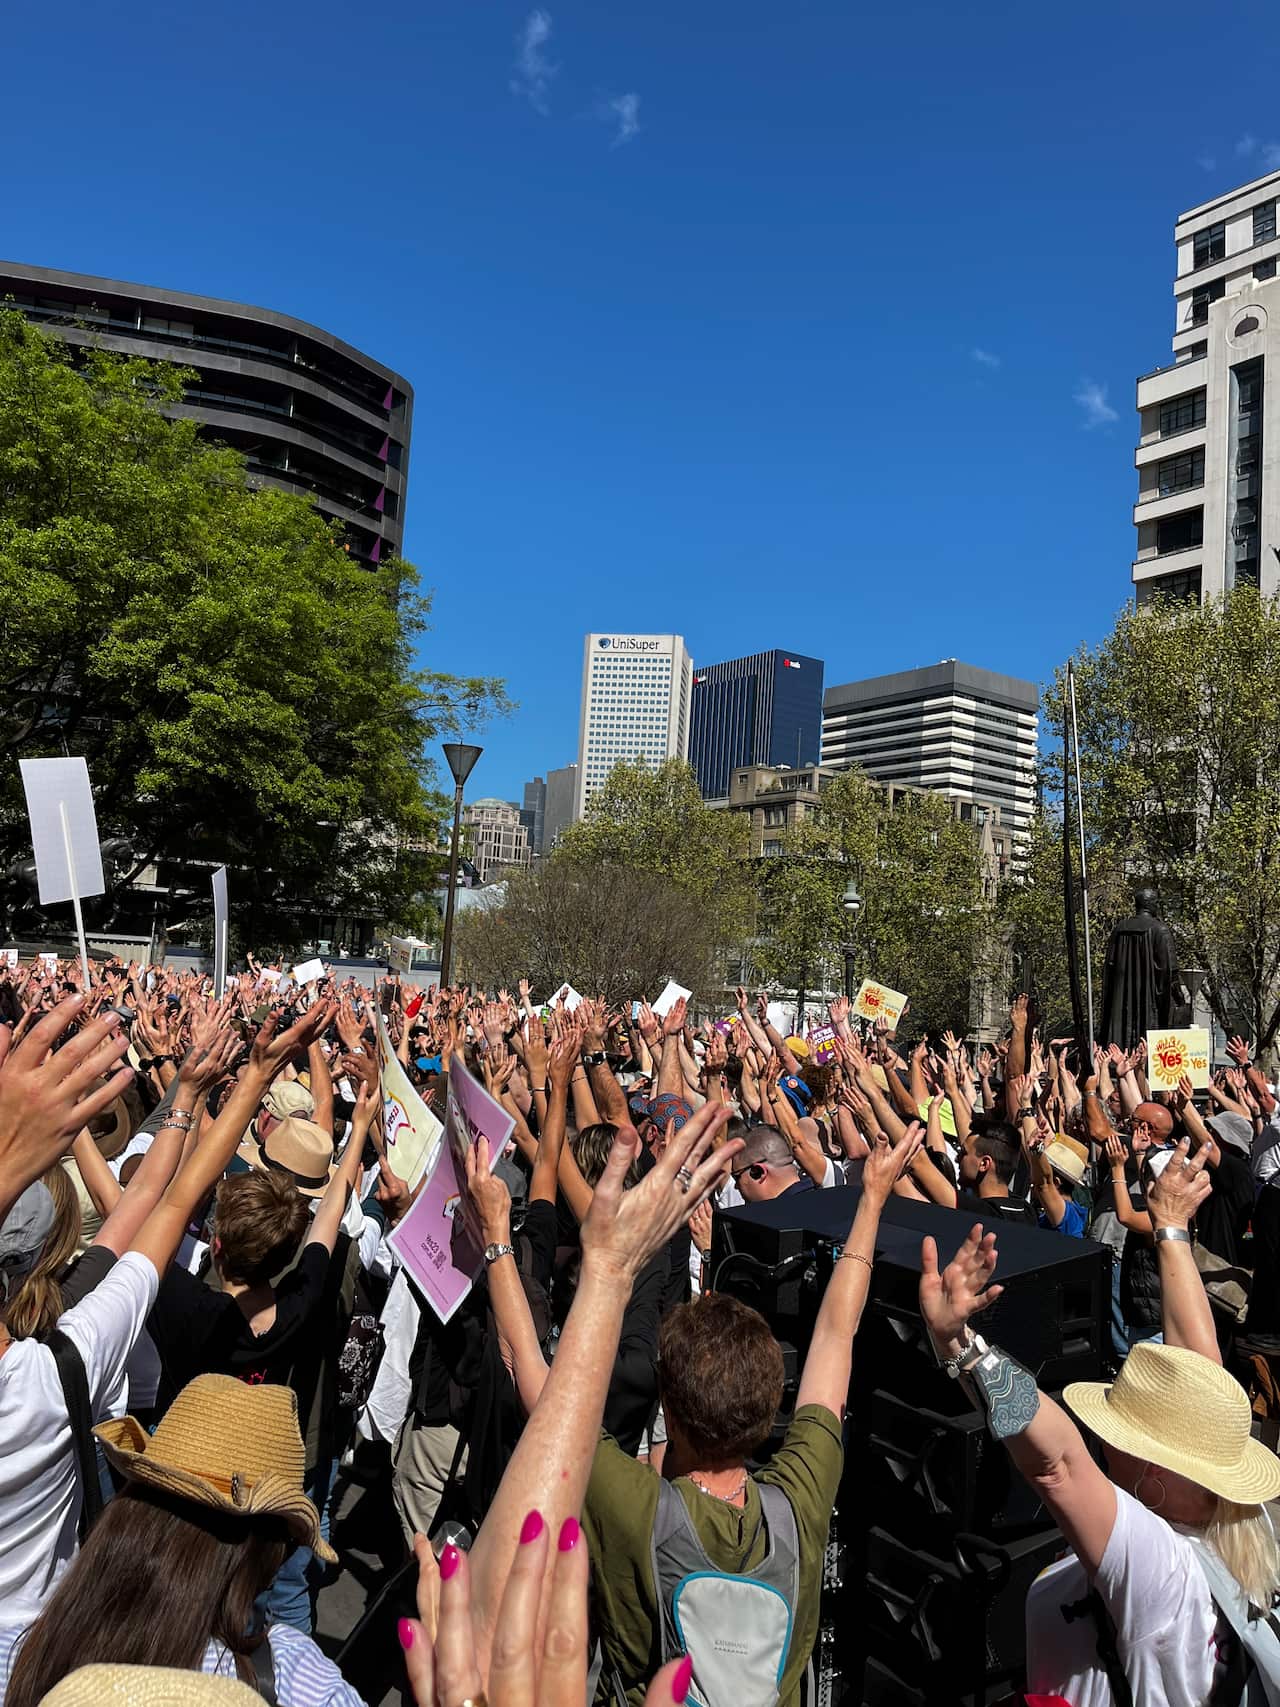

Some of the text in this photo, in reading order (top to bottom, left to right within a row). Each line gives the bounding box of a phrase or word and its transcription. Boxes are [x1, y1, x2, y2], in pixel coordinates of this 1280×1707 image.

[612, 638, 660, 653] UniSuper
[864, 993, 880, 1007] Yes
[885, 1007, 898, 1018] Yes
[1158, 1052, 1182, 1069] Yes
[1191, 1057, 1207, 1070] Yes
